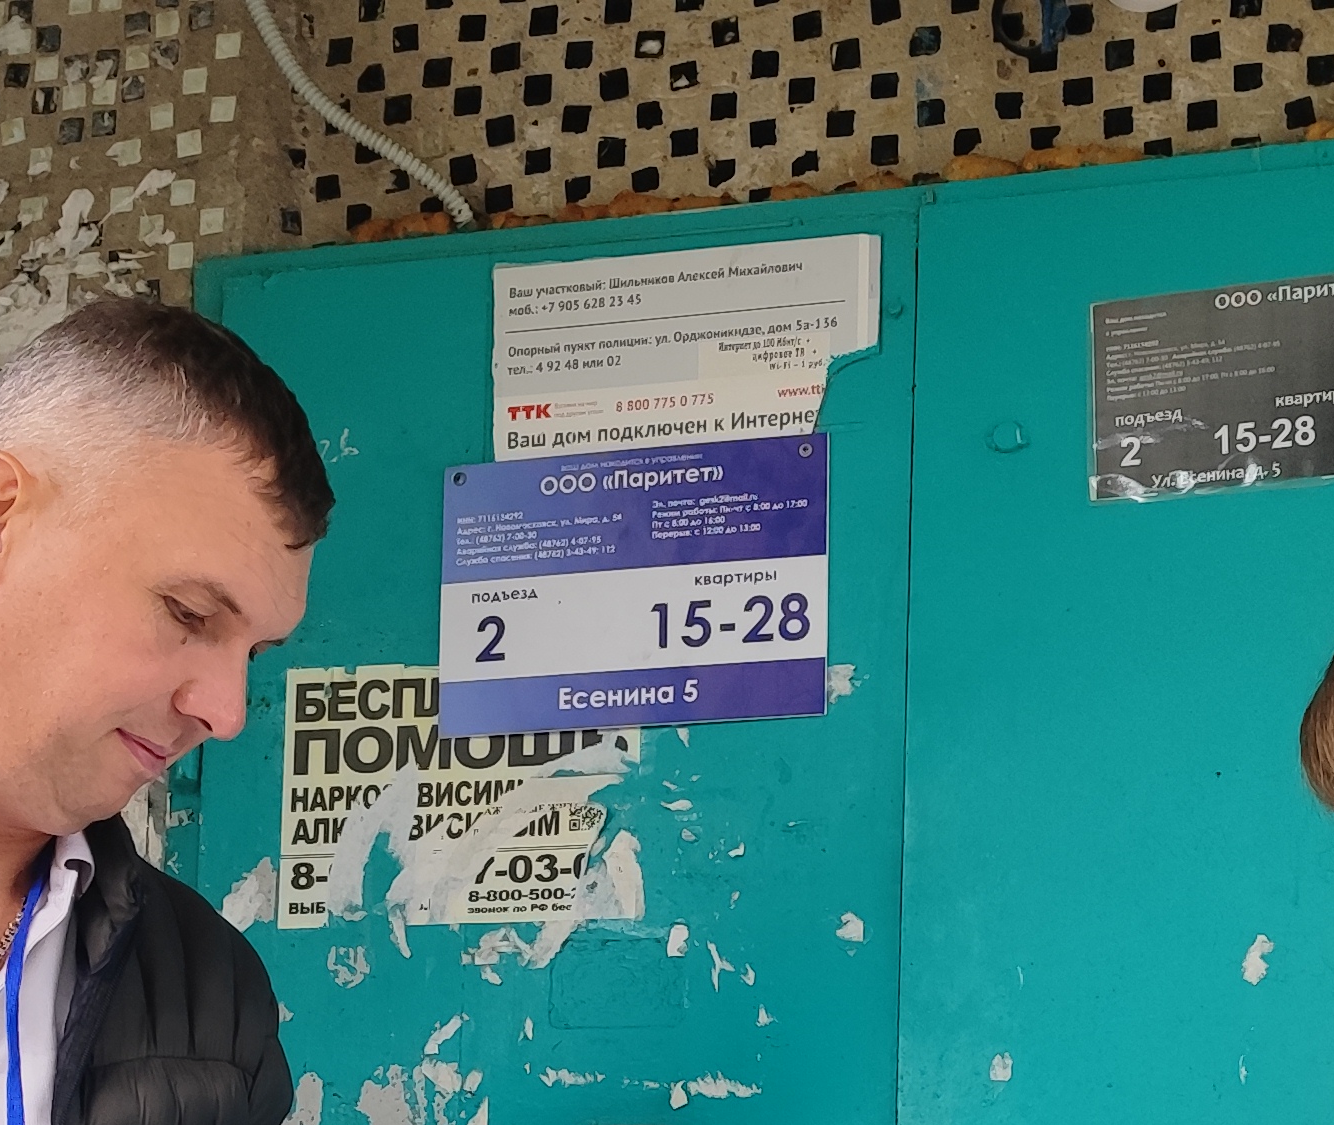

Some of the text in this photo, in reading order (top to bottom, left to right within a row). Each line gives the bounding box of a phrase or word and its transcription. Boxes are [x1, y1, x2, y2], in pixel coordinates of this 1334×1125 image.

[509, 262, 803, 299] Ваш участковый: Шильников Алексей Михайлович
[509, 293, 642, 317] моб.: +7 905 628 23 45
[1214, 289, 1263, 310] ООО
[508, 343, 560, 358] Опорный
[563, 341, 596, 355] пункт
[598, 336, 652, 349] полиции:
[655, 334, 671, 347] ул.
[673, 325, 766, 344] Орджоникидзе,
[768, 323, 792, 335] дом
[753, 341, 761, 351] до
[536, 361, 543, 373] 4
[547, 360, 561, 373] 92
[565, 358, 579, 370] 48
[583, 358, 604, 369] или
[607, 355, 621, 367] 02
[752, 348, 792, 362] цифровое
[507, 403, 552, 421] ТТК
[616, 393, 714, 412] 8 800 775 0 775
[1115, 406, 1183, 428] подъезд
[507, 408, 819, 450] Ваш дом подключен к Интерне
[1120, 415, 1317, 467] 2 15-28
[540, 465, 724, 496] ООО «Паритет»
[1151, 474, 1175, 489] Ул.
[1271, 461, 1282, 478] 5
[771, 502, 784, 511] до
[785, 499, 809, 509] 17:00
[651, 519, 663, 529] Пт
[690, 517, 703, 527] до
[724, 524, 738, 535] до
[694, 568, 778, 587] квартиры
[471, 585, 539, 605] подъезд
[475, 592, 811, 663] 2 15-28
[557, 679, 699, 711] Есенина 5
[290, 862, 332, 891] 8-
[467, 903, 573, 914] звонок по РФ бес
